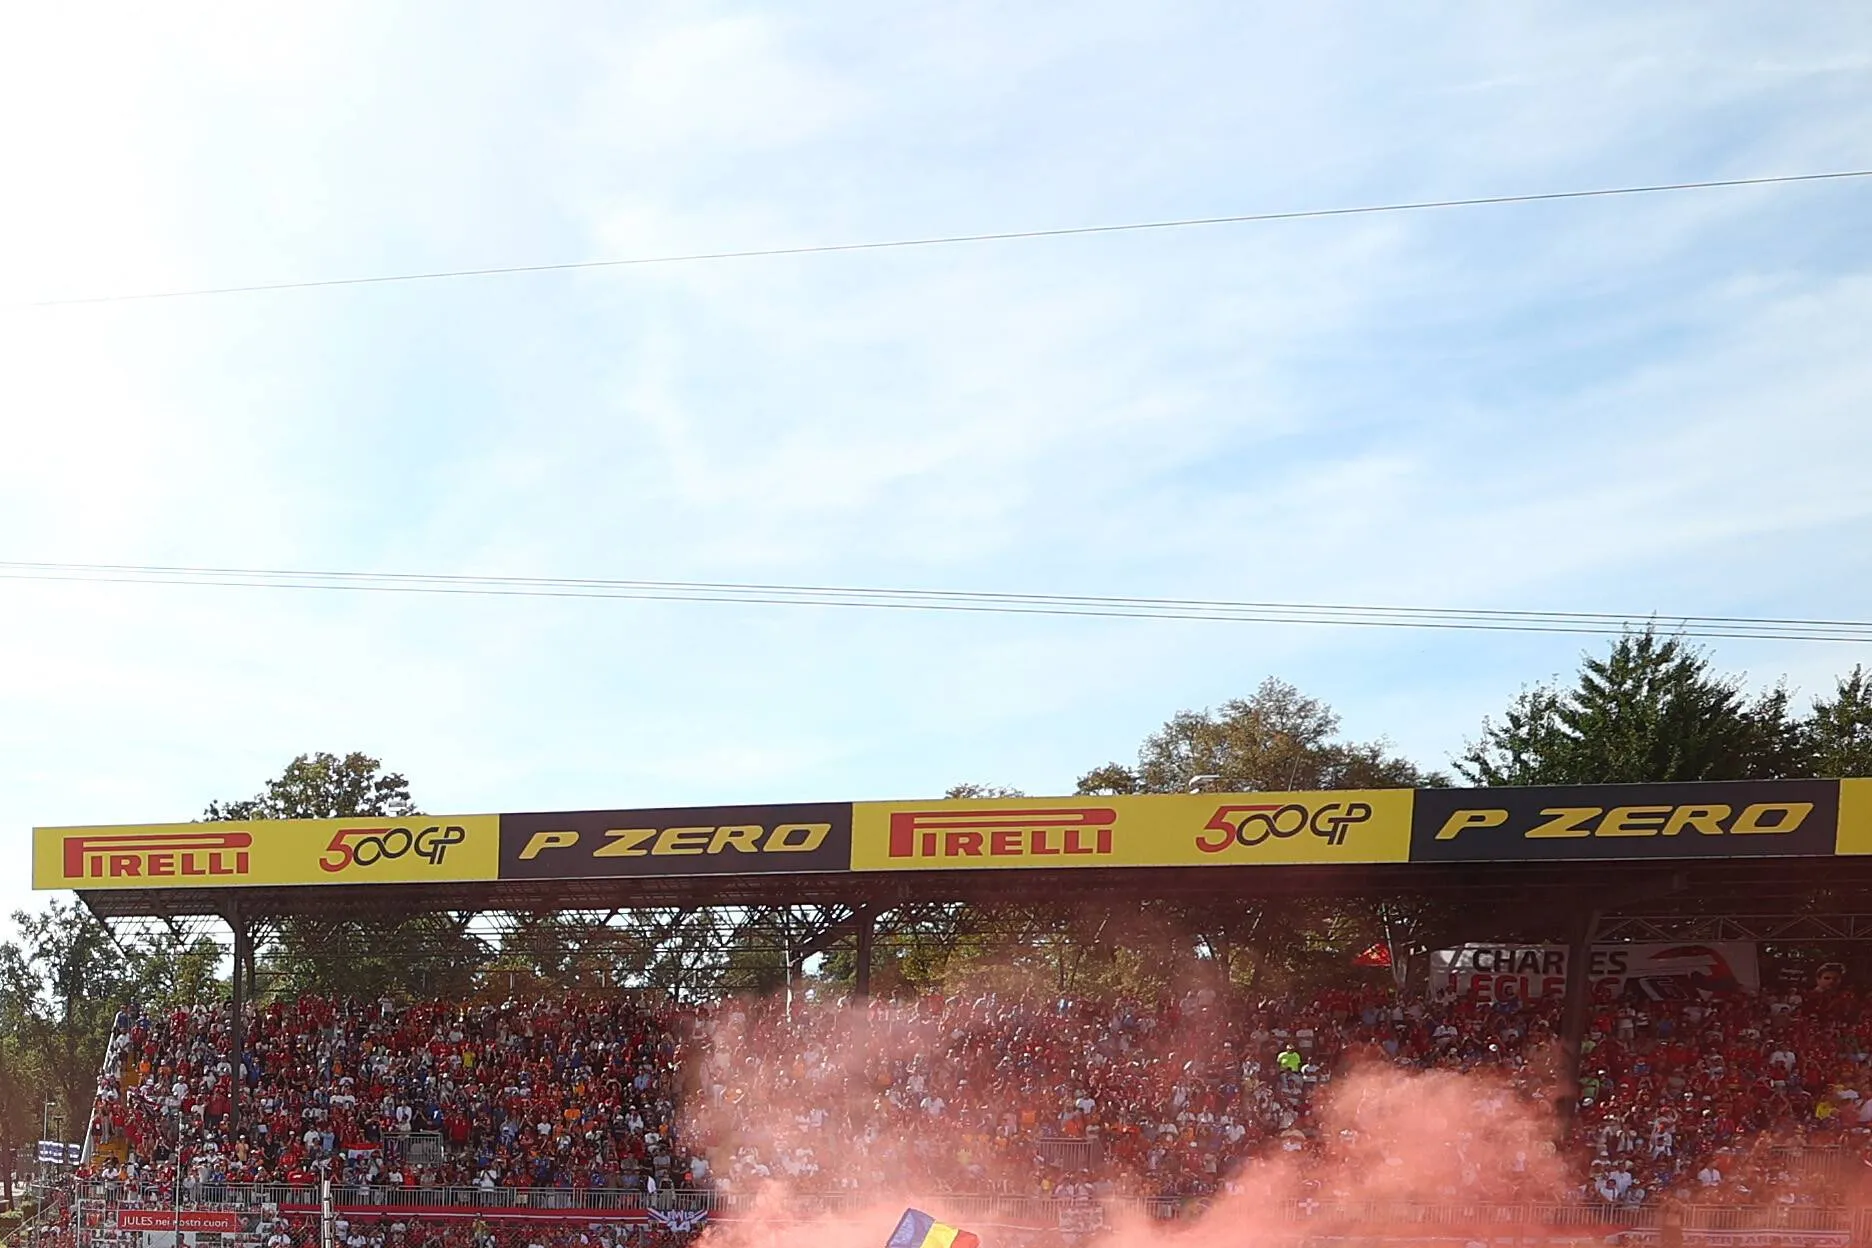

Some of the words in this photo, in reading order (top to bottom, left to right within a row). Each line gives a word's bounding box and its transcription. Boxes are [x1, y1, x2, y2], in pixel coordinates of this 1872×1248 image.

[518, 829, 581, 860] P
[591, 822, 832, 858] ZERO
[888, 807, 1117, 859] PIRELLI
[1195, 802, 1372, 853] 500GP
[1434, 808, 1509, 841] P
[1524, 802, 1814, 840] ZERO
[62, 831, 253, 879] PIRELLI
[318, 825, 466, 873] 500GP
[1472, 949, 1629, 975] CHARES
[121, 1216, 153, 1228] JULES
[155, 1217, 171, 1227] nei
[203, 1217, 229, 1228] cuori
